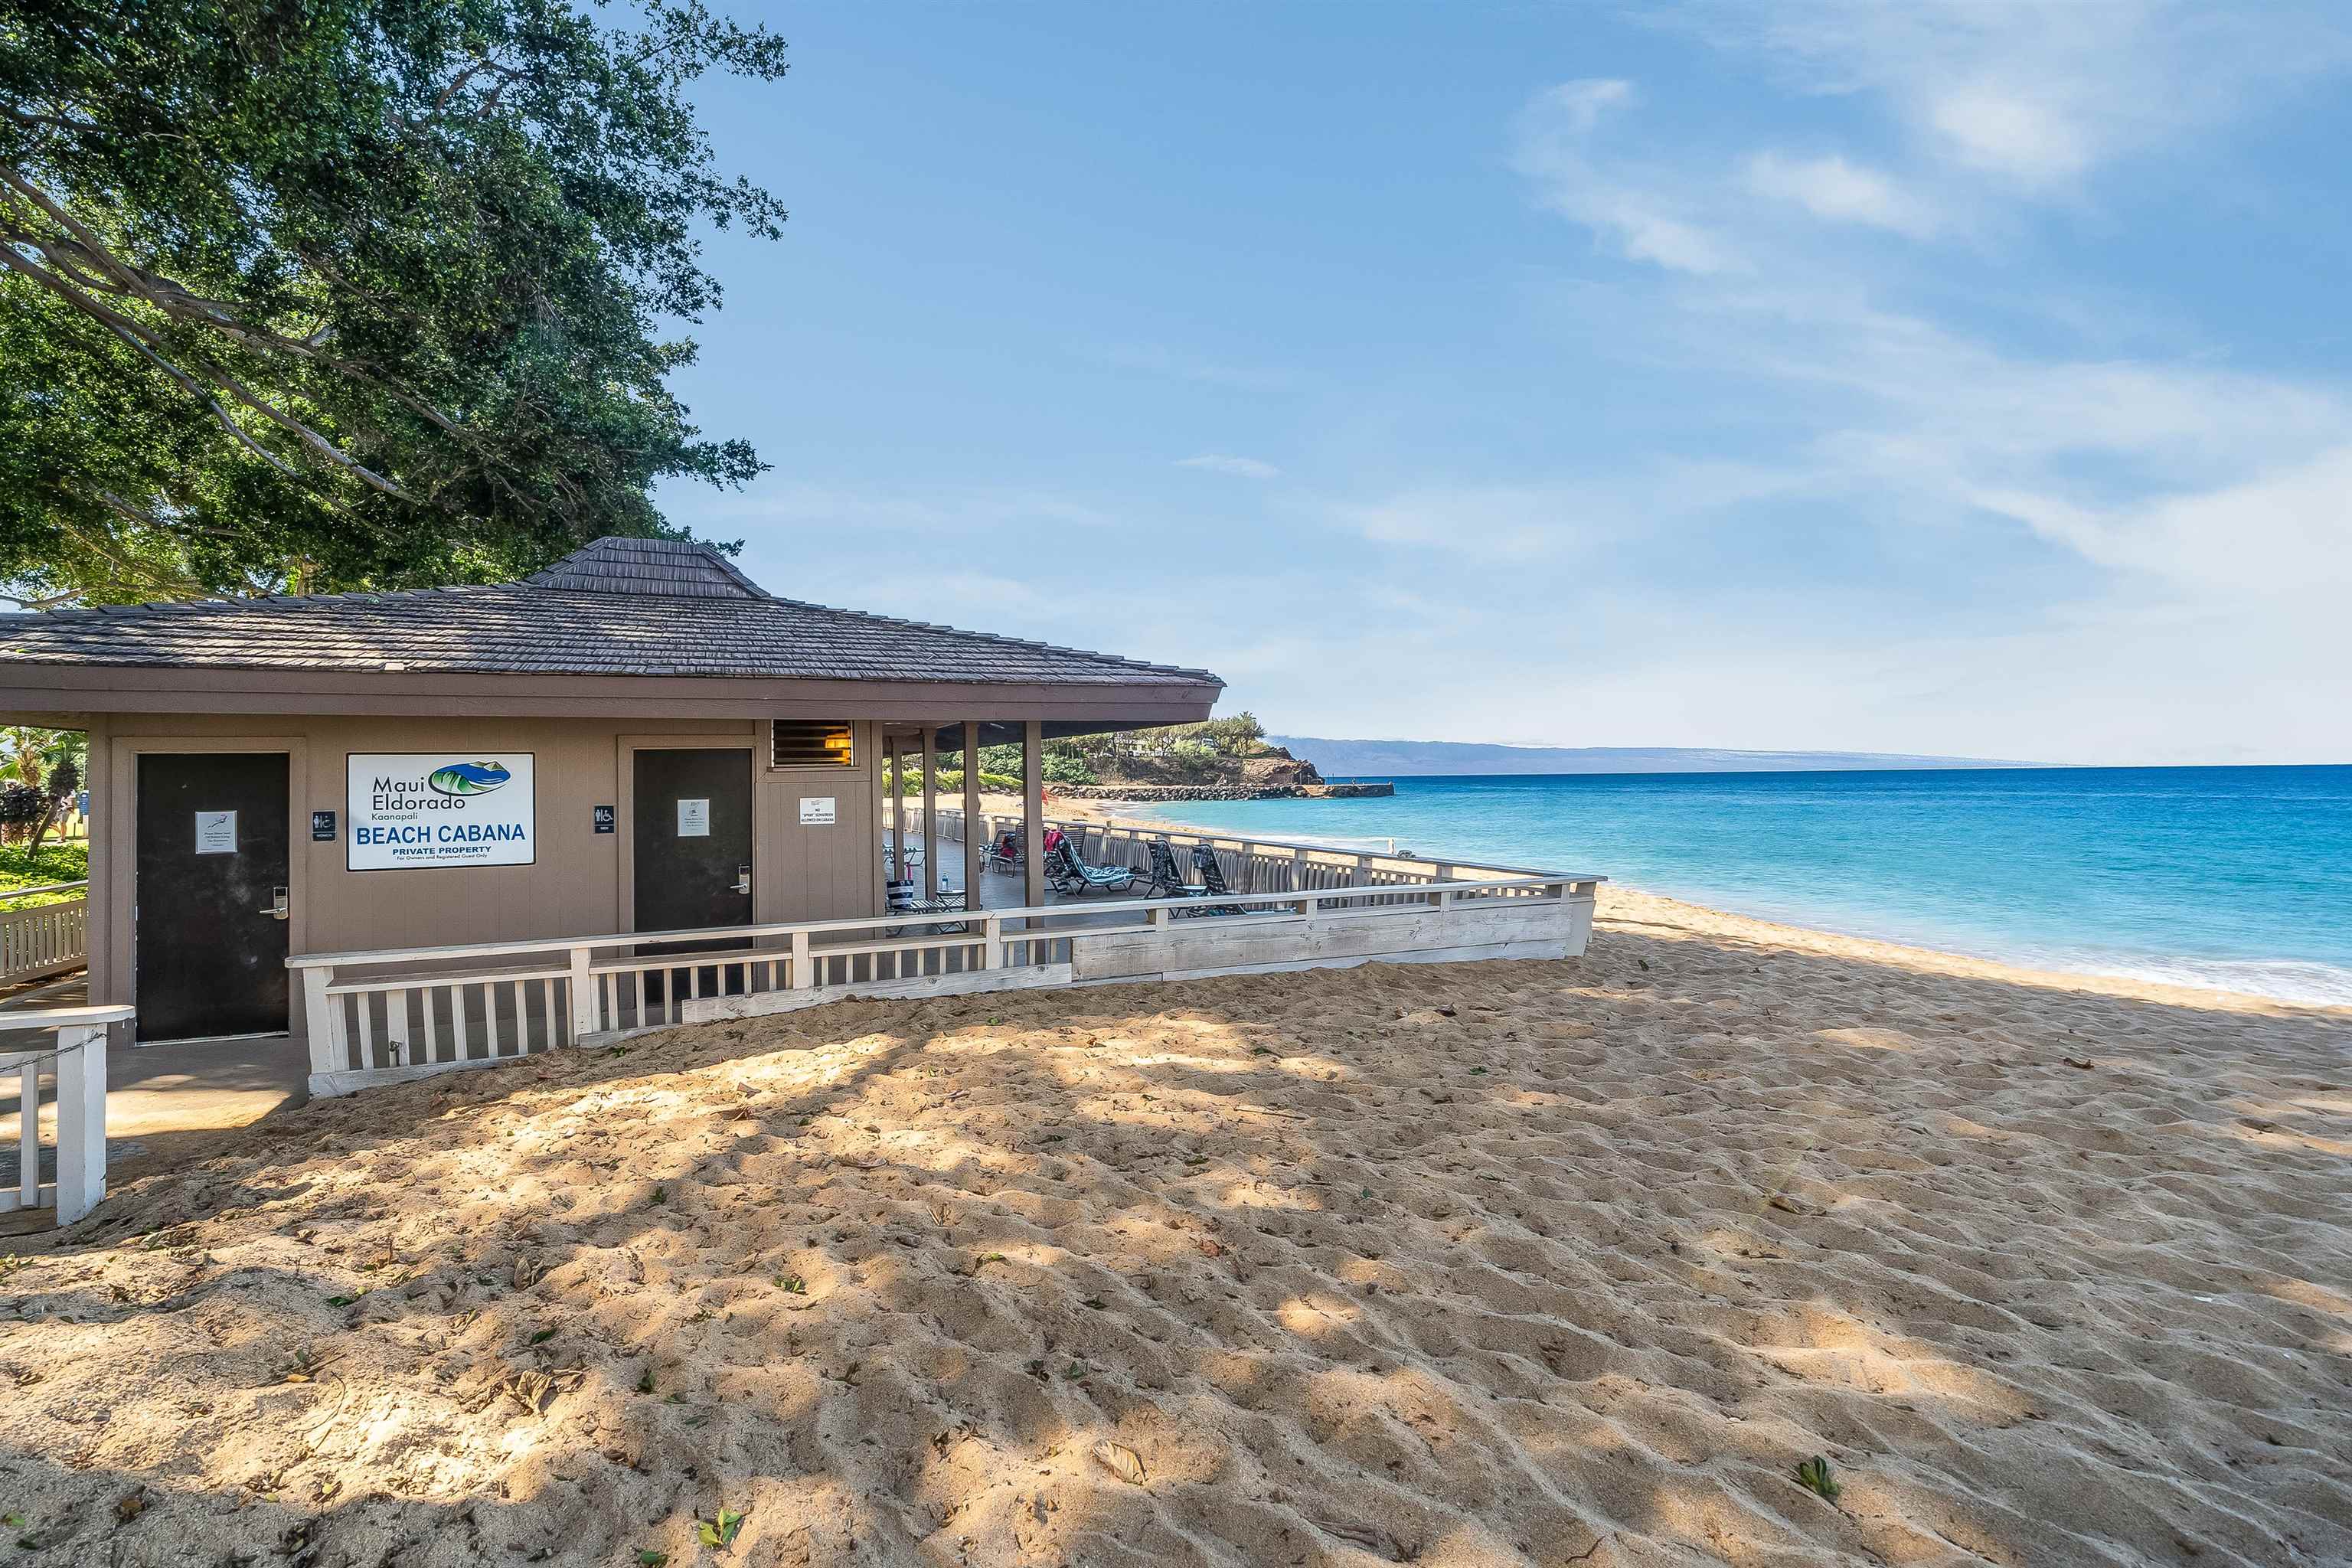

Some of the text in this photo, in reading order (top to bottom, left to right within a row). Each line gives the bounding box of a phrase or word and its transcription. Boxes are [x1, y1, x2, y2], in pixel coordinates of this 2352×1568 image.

[372, 776, 424, 792] Maui
[372, 793, 466, 810] Eldorado
[371, 812, 418, 822] Kaanapali
[357, 824, 526, 844] BEACH CABANA
[439, 846, 492, 854] PROPERTY
